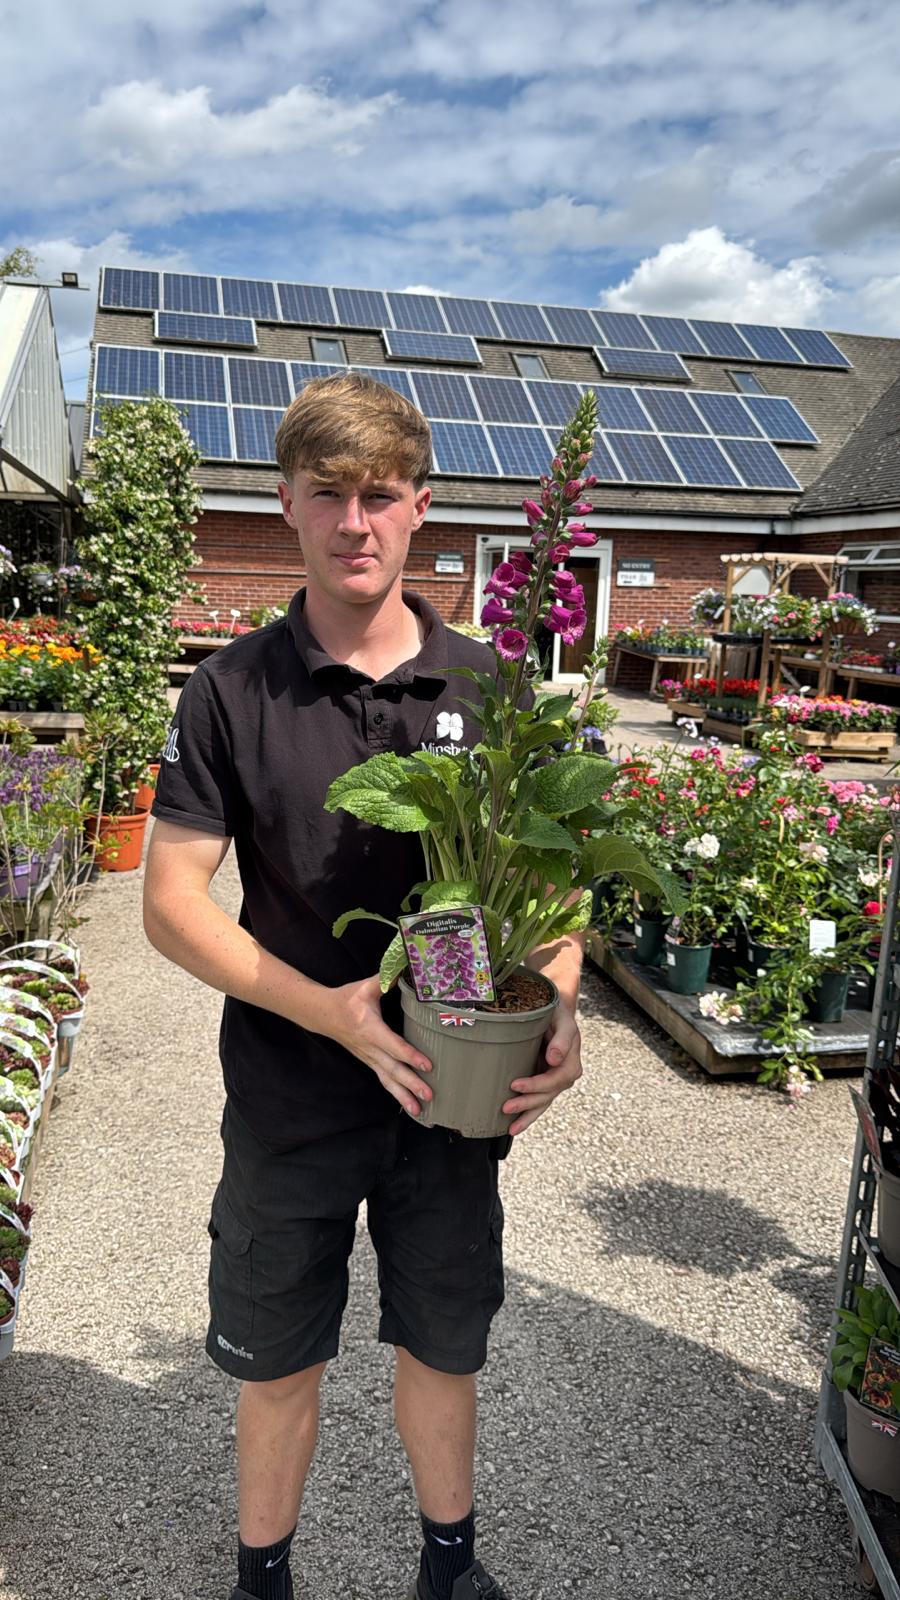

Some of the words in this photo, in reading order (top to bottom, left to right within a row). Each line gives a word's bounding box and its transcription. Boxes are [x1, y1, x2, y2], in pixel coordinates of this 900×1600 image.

[426, 918, 458, 927] Digitalis
[415, 925, 449, 935] Dalmatian
[449, 922, 471, 931] Purple
